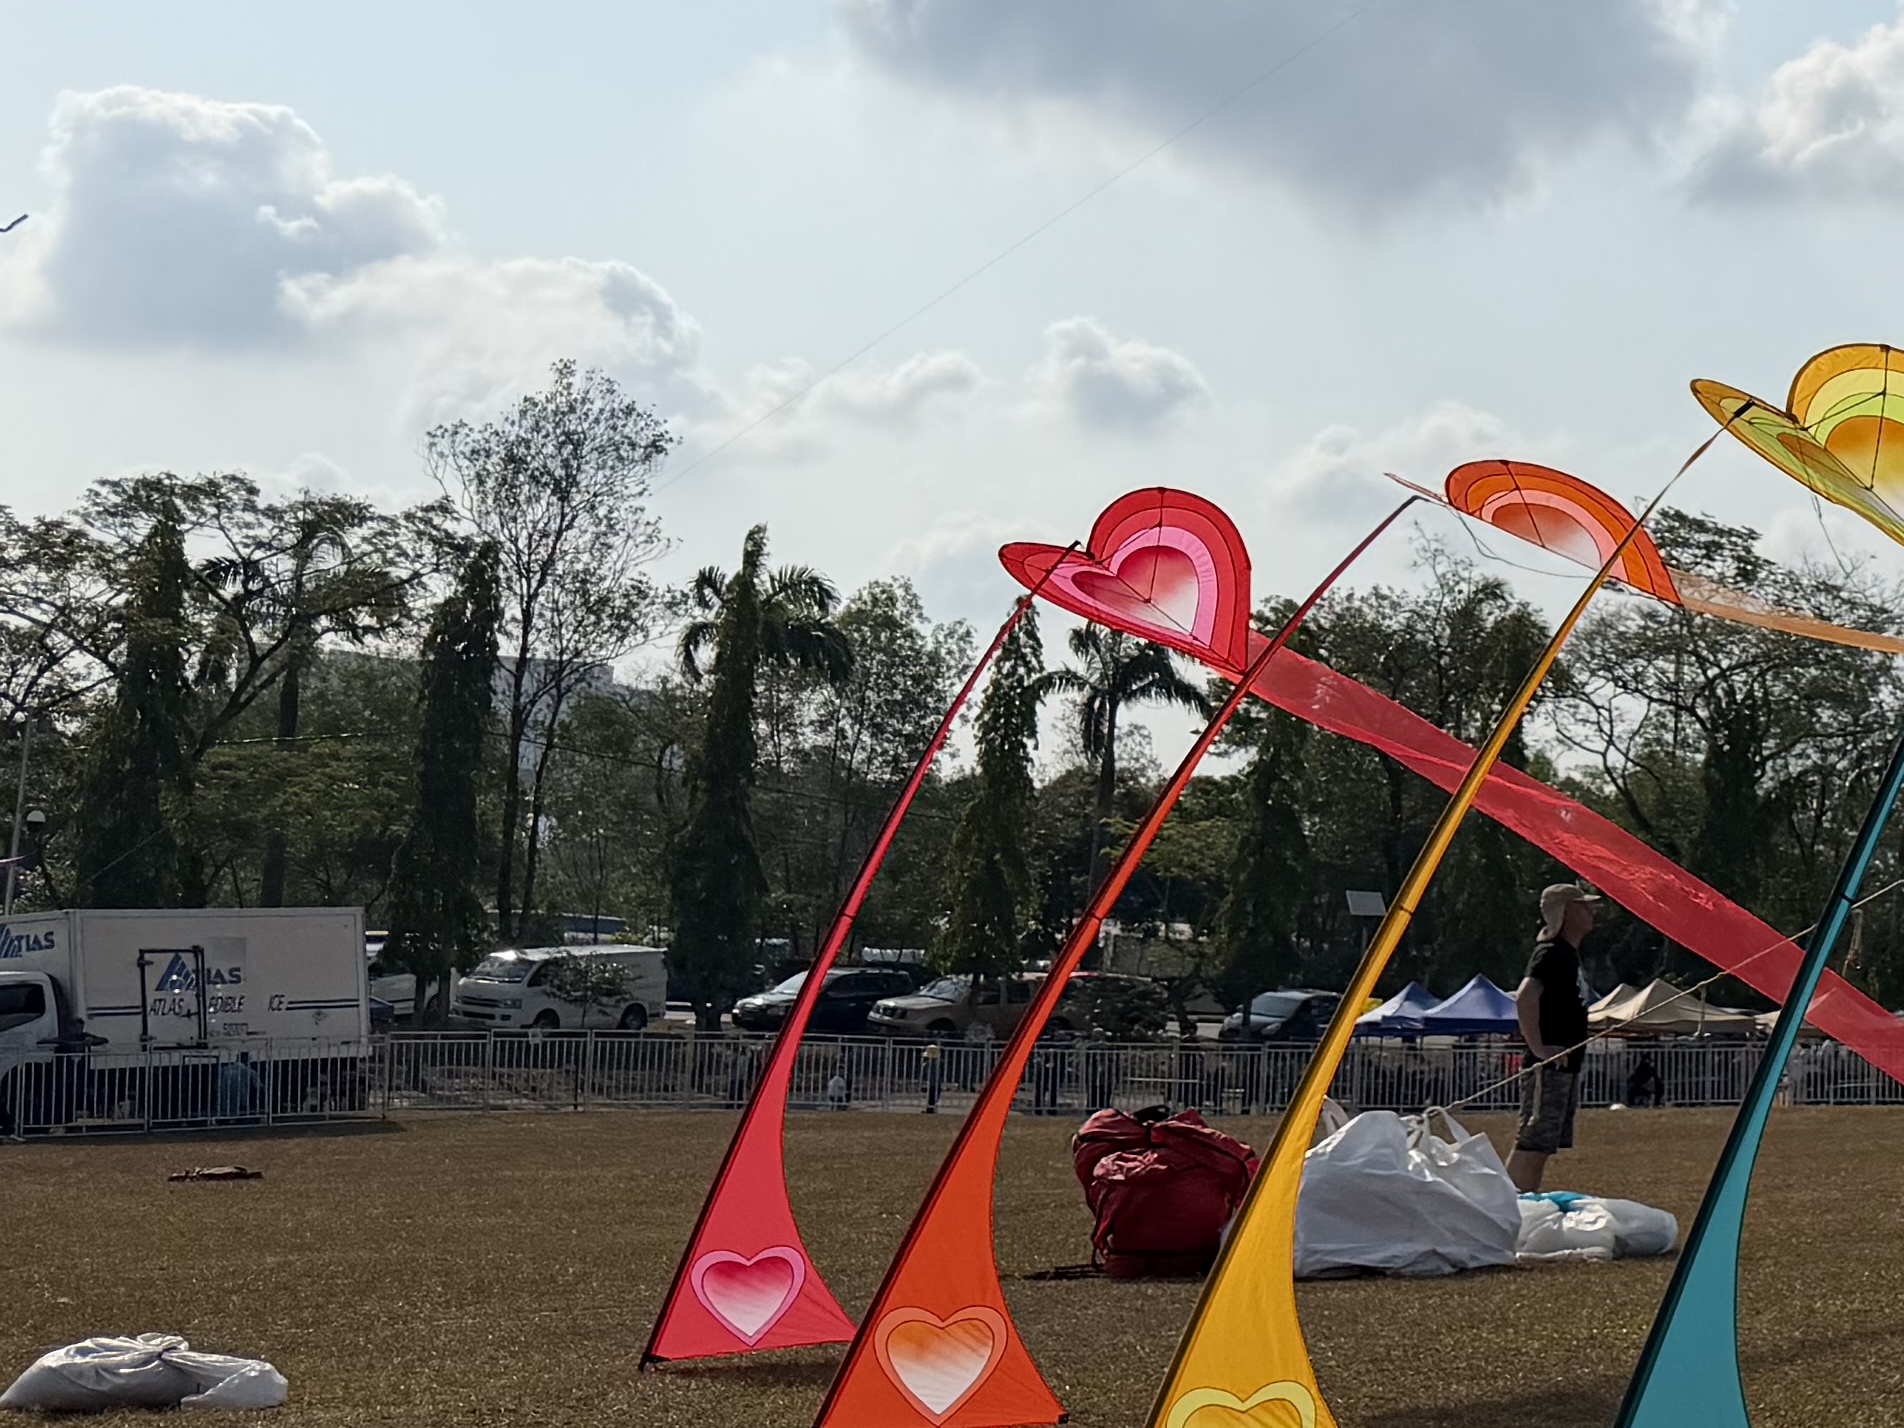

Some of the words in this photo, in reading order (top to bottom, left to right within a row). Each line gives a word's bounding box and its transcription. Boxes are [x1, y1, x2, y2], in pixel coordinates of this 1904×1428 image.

[150, 998, 184, 1016] ATLAS
[208, 996, 246, 1015] EDIBLE
[268, 994, 285, 1011] ICE
